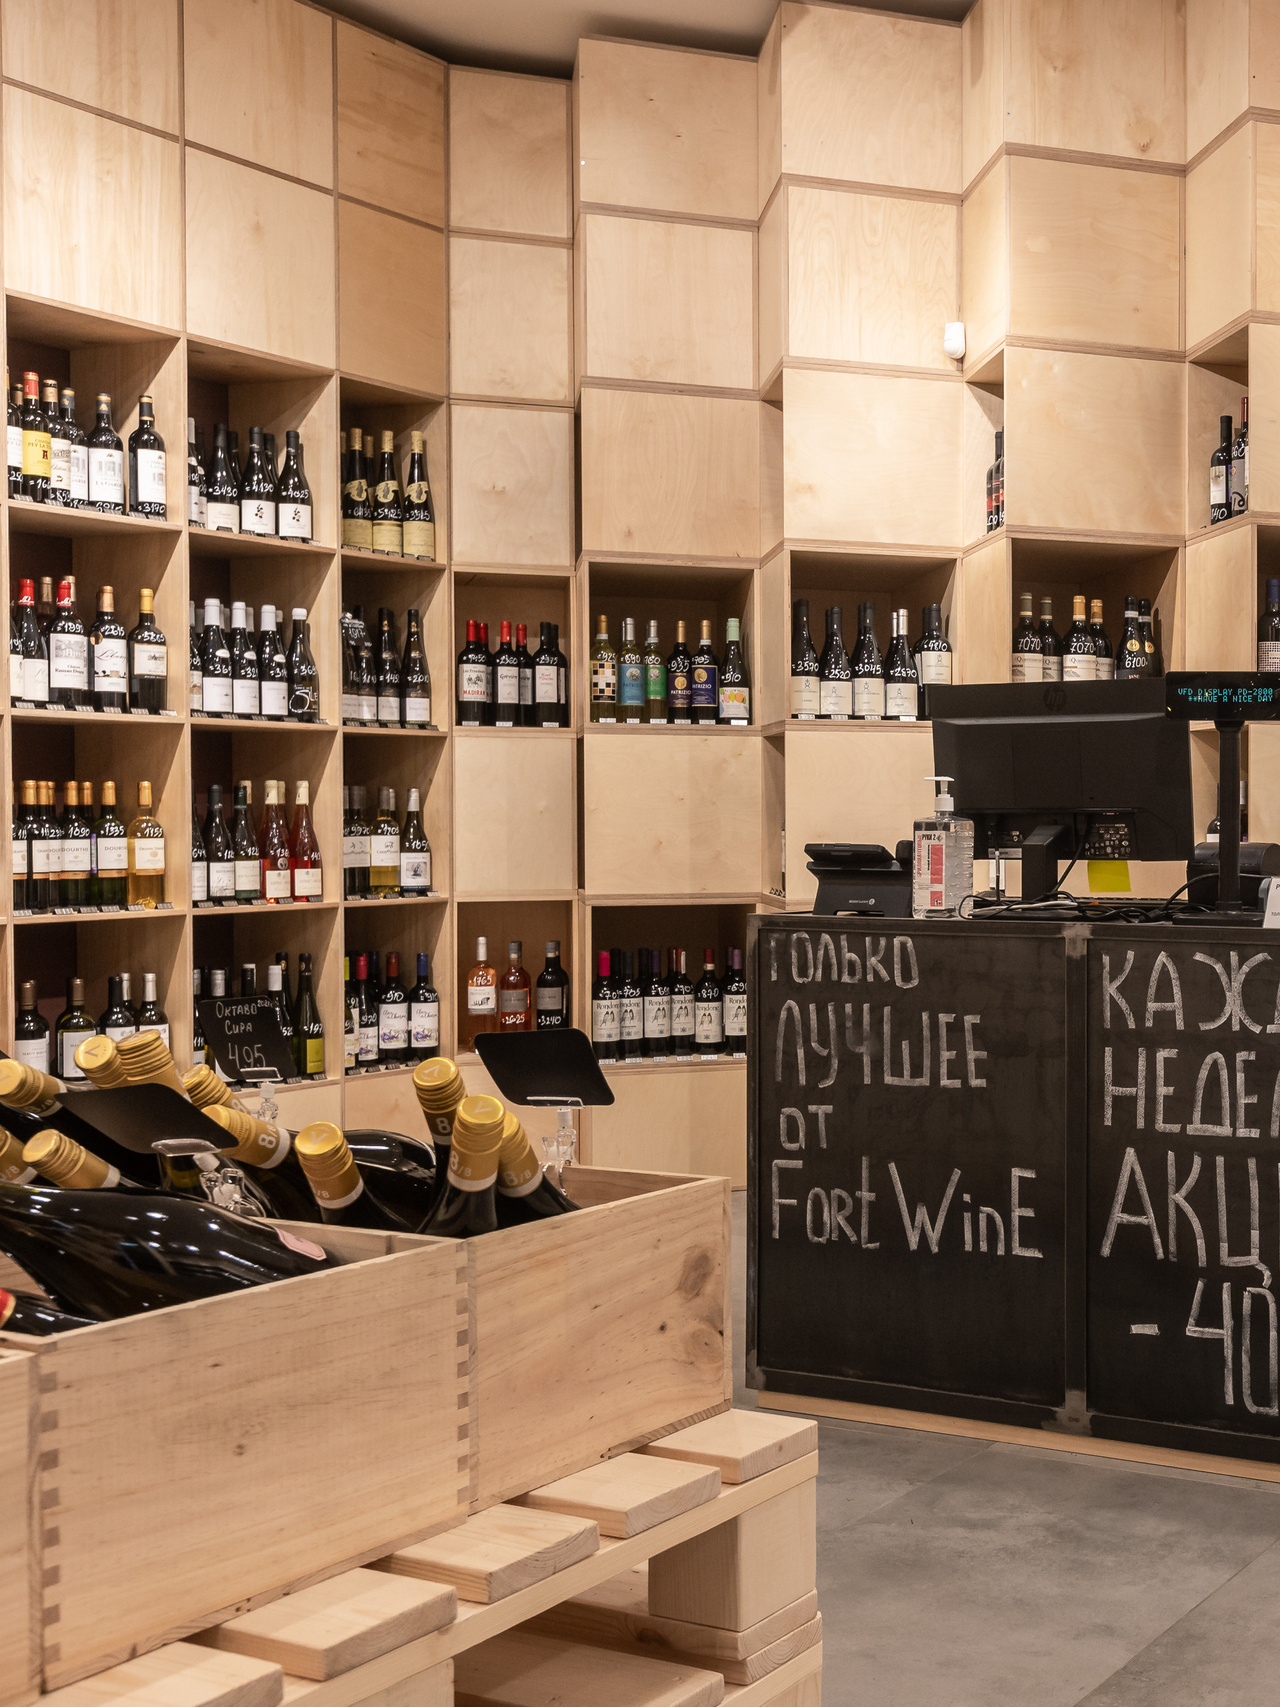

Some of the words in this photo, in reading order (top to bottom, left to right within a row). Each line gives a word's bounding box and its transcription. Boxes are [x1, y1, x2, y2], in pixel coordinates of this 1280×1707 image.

[769, 932, 919, 988] ТОЛЬКО
[228, 1043, 266, 1069] 495
[775, 999, 988, 1088] ЛУЧШЕЕ
[779, 1104, 833, 1150] ОТ
